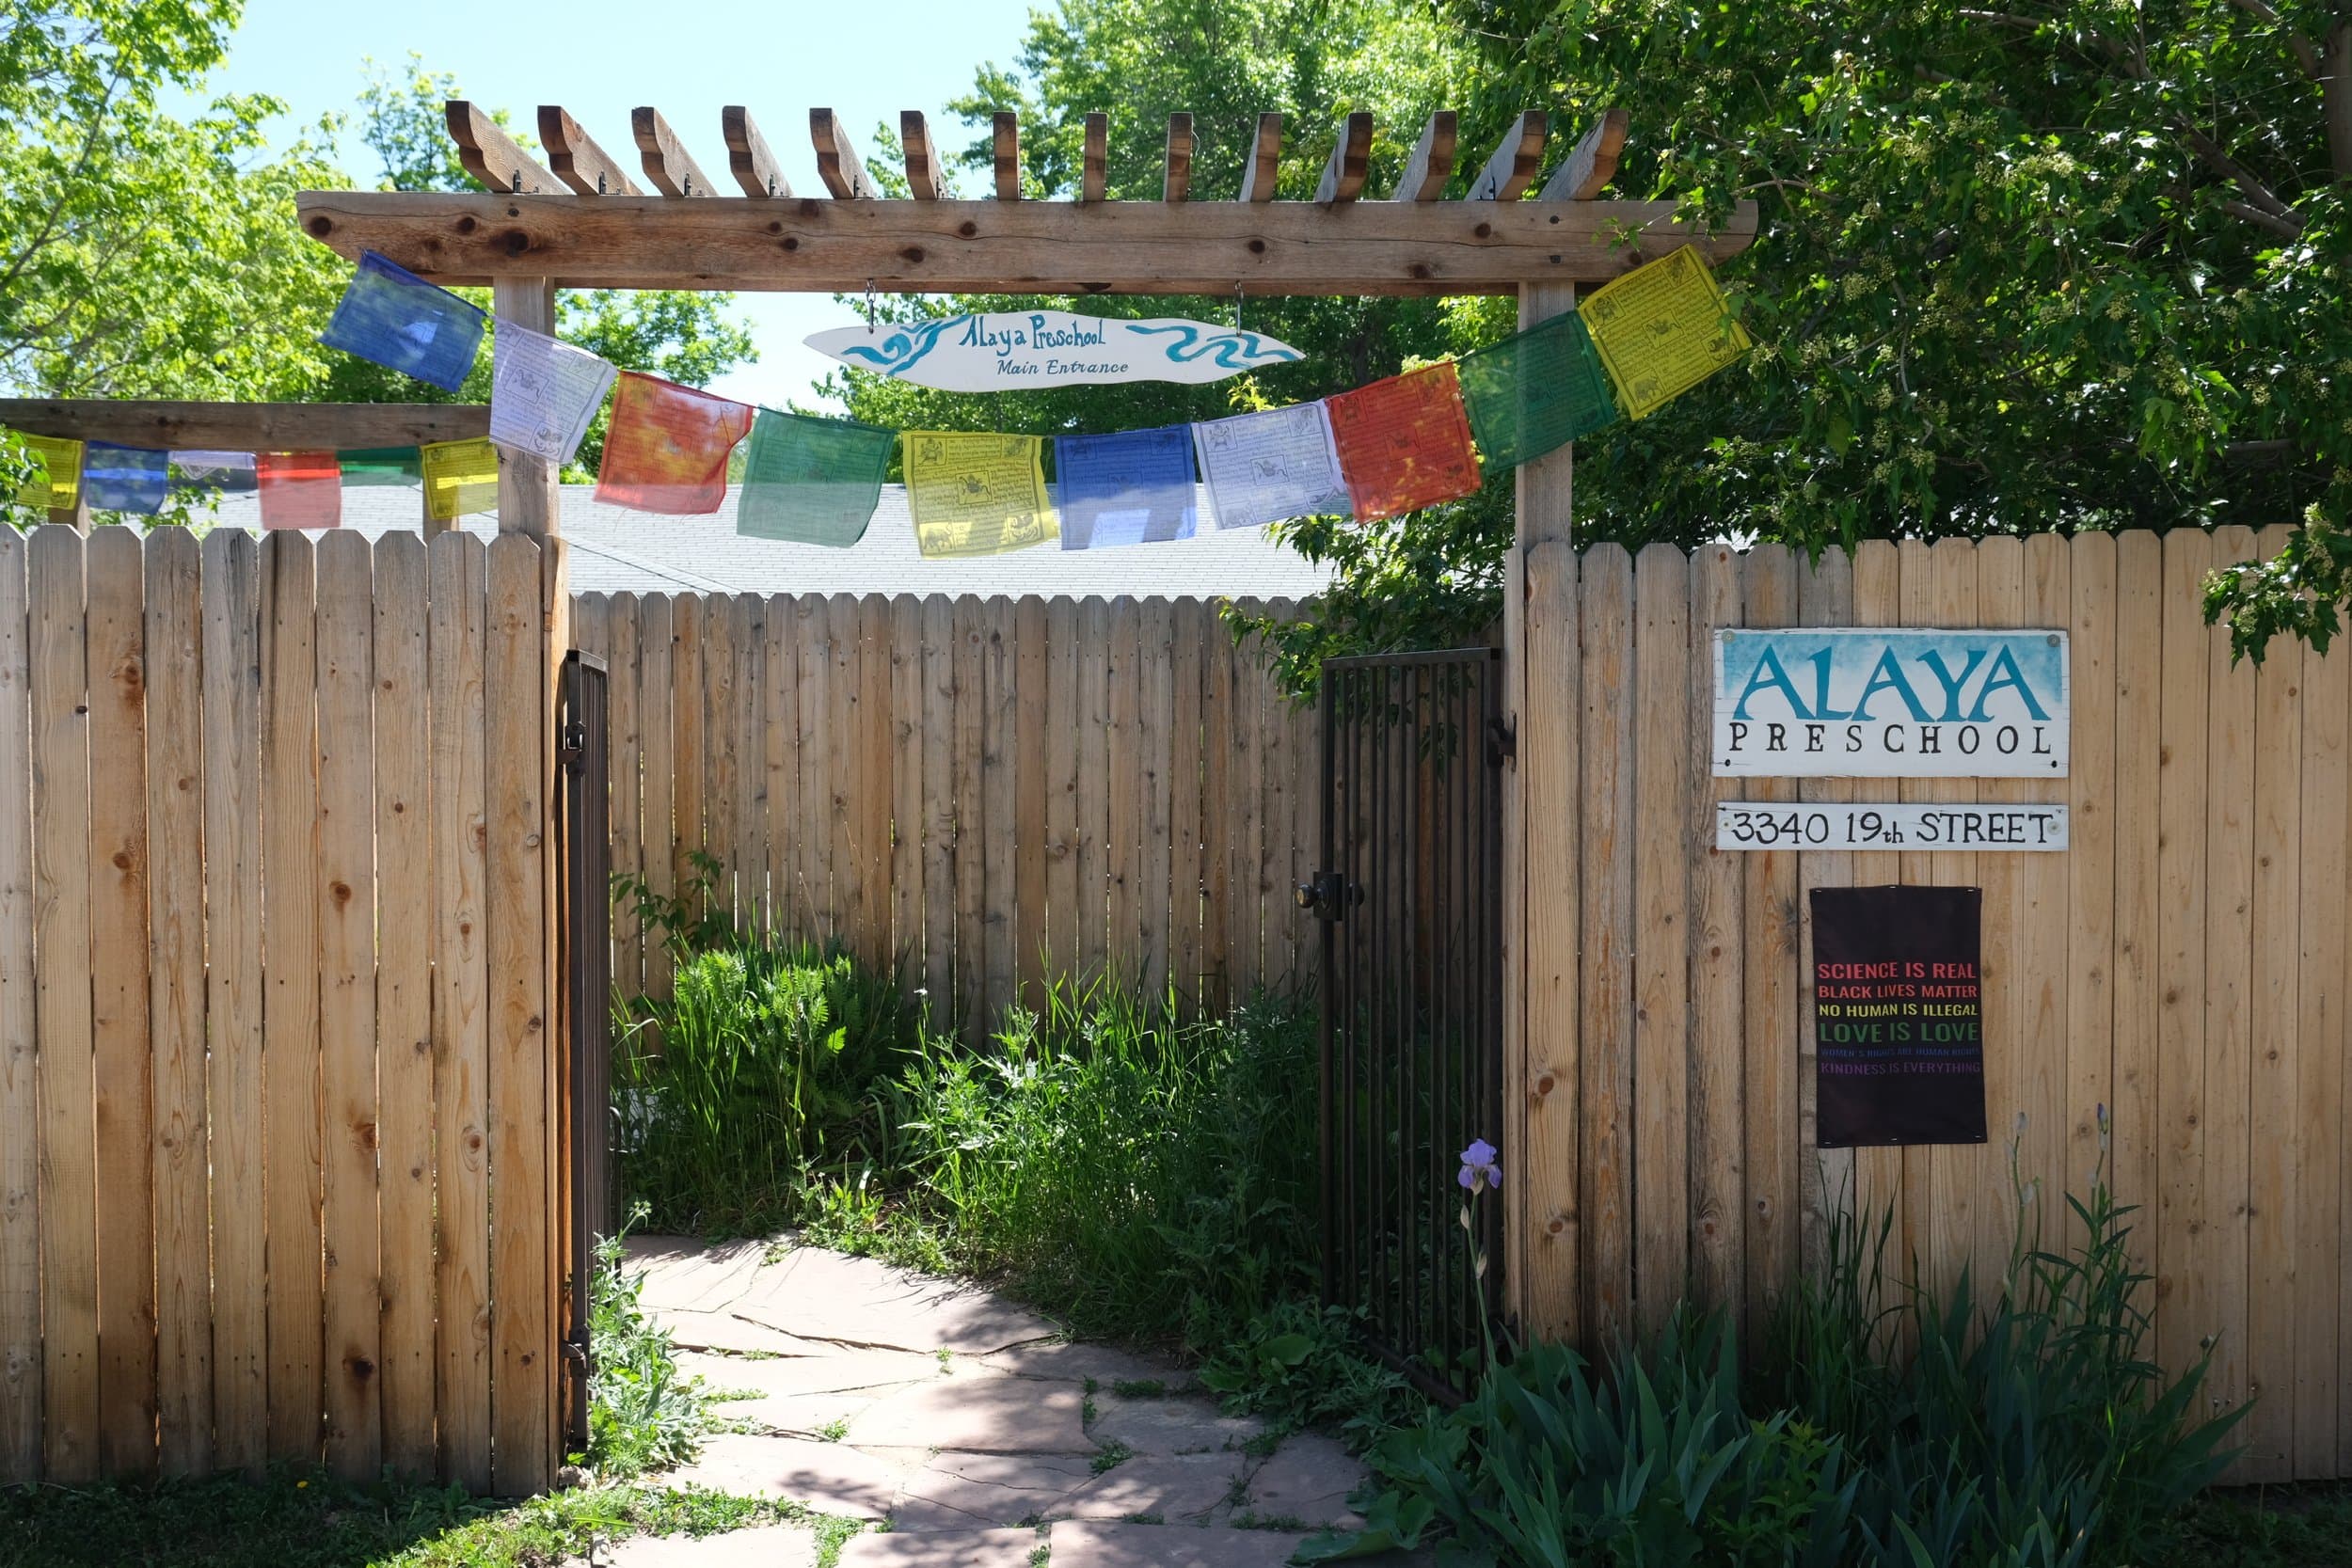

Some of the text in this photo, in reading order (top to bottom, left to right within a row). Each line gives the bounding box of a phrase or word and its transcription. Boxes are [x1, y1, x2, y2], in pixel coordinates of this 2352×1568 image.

[959, 314, 1105, 356] Alaya Preschool
[997, 359, 1129, 374] Main Entrance
[1732, 643, 2052, 722] ALAYA
[1728, 722, 2052, 753] PRESCHOOL
[1732, 812, 2054, 844] 3340 19th STREET
[1818, 962, 1977, 979] SCIENCE IS REAL
[1819, 984, 1978, 999] BLACK LIVES MATTER
[1819, 1003, 1979, 1017] NO HUMAN IS ILLEGAL
[1820, 1022, 1979, 1043] LOVE IS LOVE
[1820, 1062, 1980, 1076] KINDNESS IS EVERYTHING
